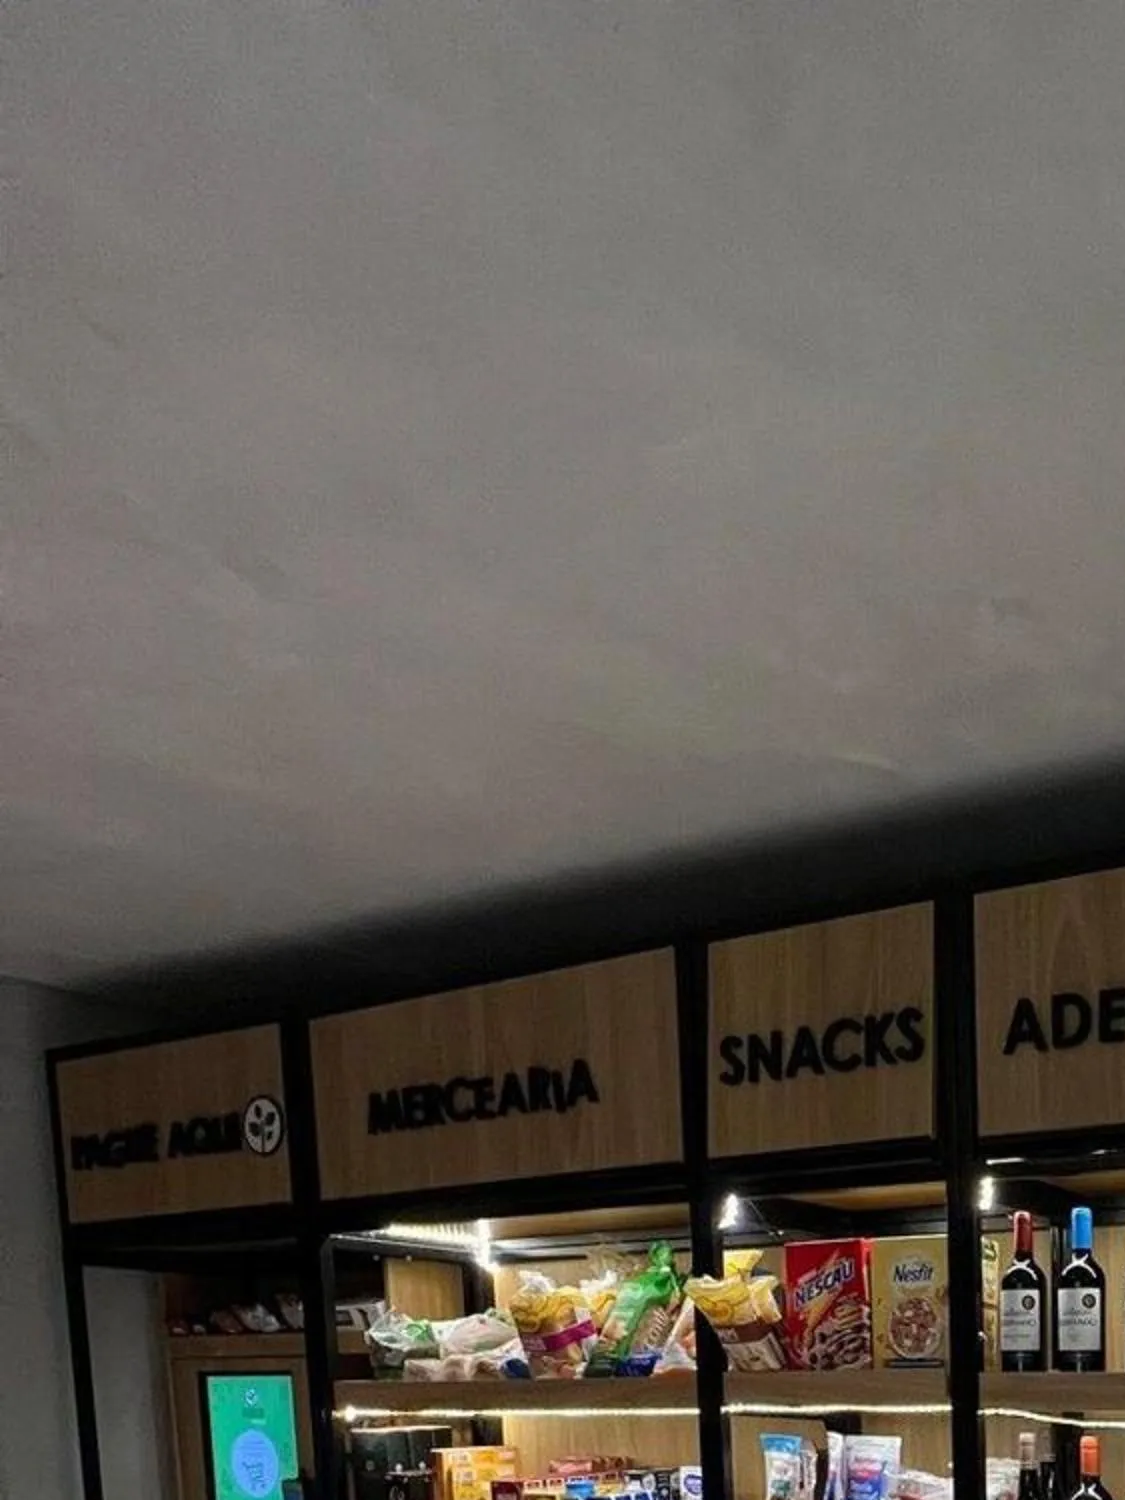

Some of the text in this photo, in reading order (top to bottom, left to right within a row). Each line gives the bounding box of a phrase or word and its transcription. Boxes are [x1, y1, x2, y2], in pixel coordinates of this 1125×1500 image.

[719, 1007, 926, 1087] SNACKS
[367, 1059, 599, 1136] MERCEARIA
[794, 1260, 853, 1308] NESCAU
[893, 1263, 934, 1283] Nesfit
